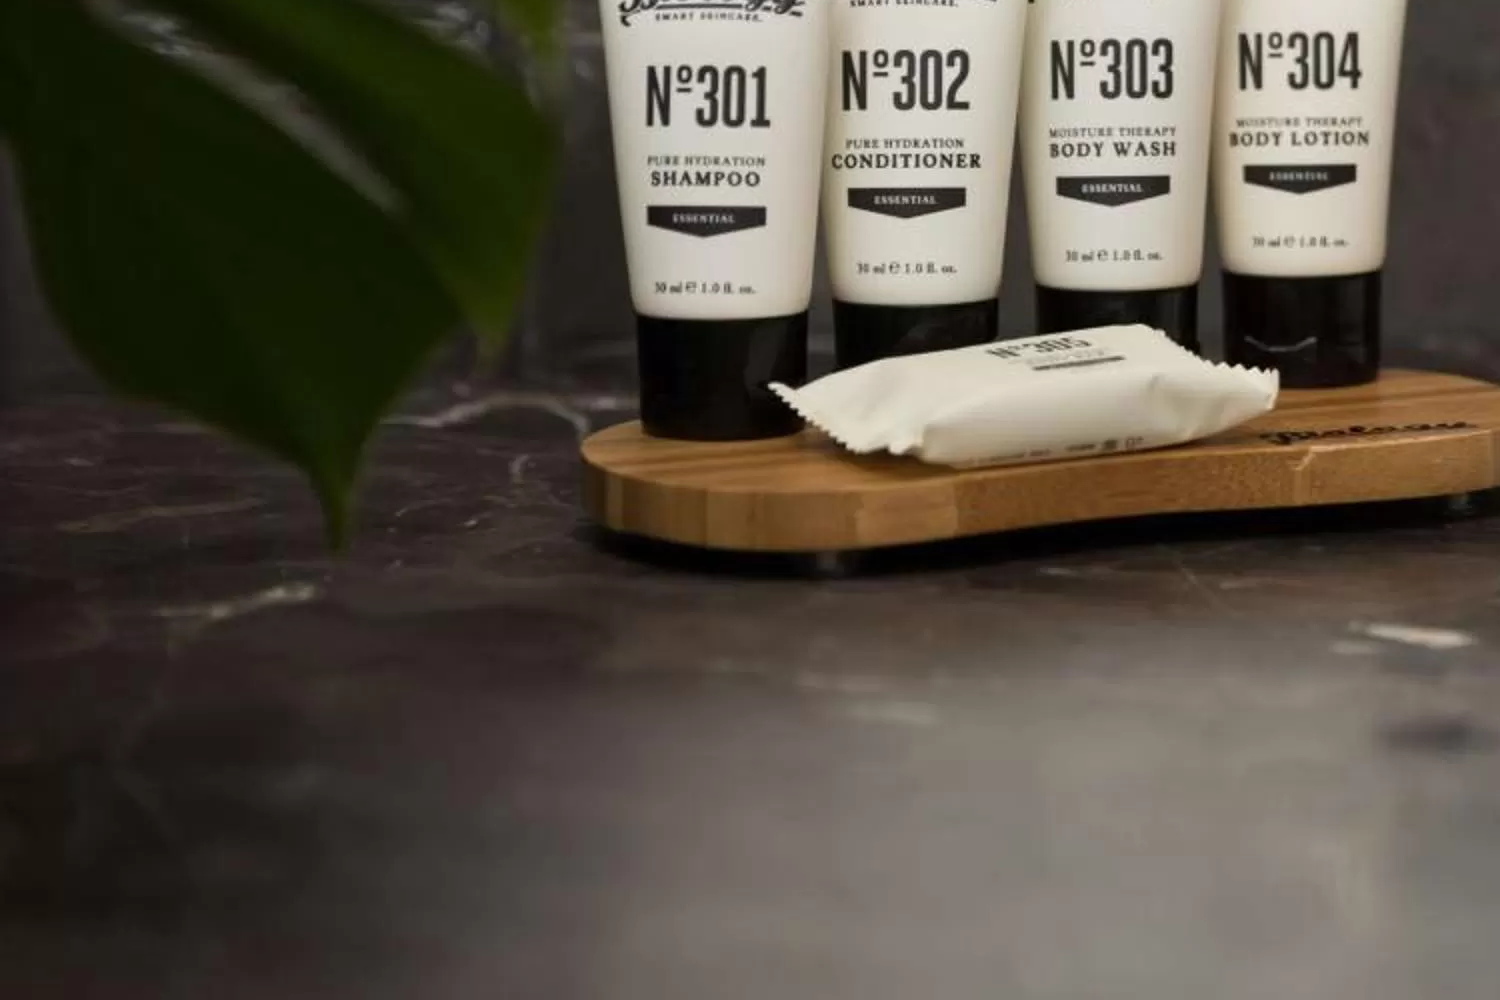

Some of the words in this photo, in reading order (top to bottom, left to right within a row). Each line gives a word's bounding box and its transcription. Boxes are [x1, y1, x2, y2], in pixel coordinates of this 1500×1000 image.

[1049, 127, 1113, 138] MOISTURE
[1119, 126, 1176, 137] THERAPY
[845, 138, 880, 149] PURE
[884, 138, 965, 149] HYDRATION
[1229, 131, 1282, 147] BODY
[1291, 131, 1369, 147] LOTION
[1049, 142, 1104, 158] BODY
[1113, 141, 1176, 157] WASH
[647, 155, 680, 167] PURE
[685, 155, 766, 167] HYDRATION
[831, 153, 981, 169] CONDITIONER
[650, 170, 761, 188] SHAMPOO
[1081, 183, 1142, 193] ESSENTIAL
[873, 195, 937, 205] ESSENTIAL
[672, 213, 735, 224] ESSENTIAL
